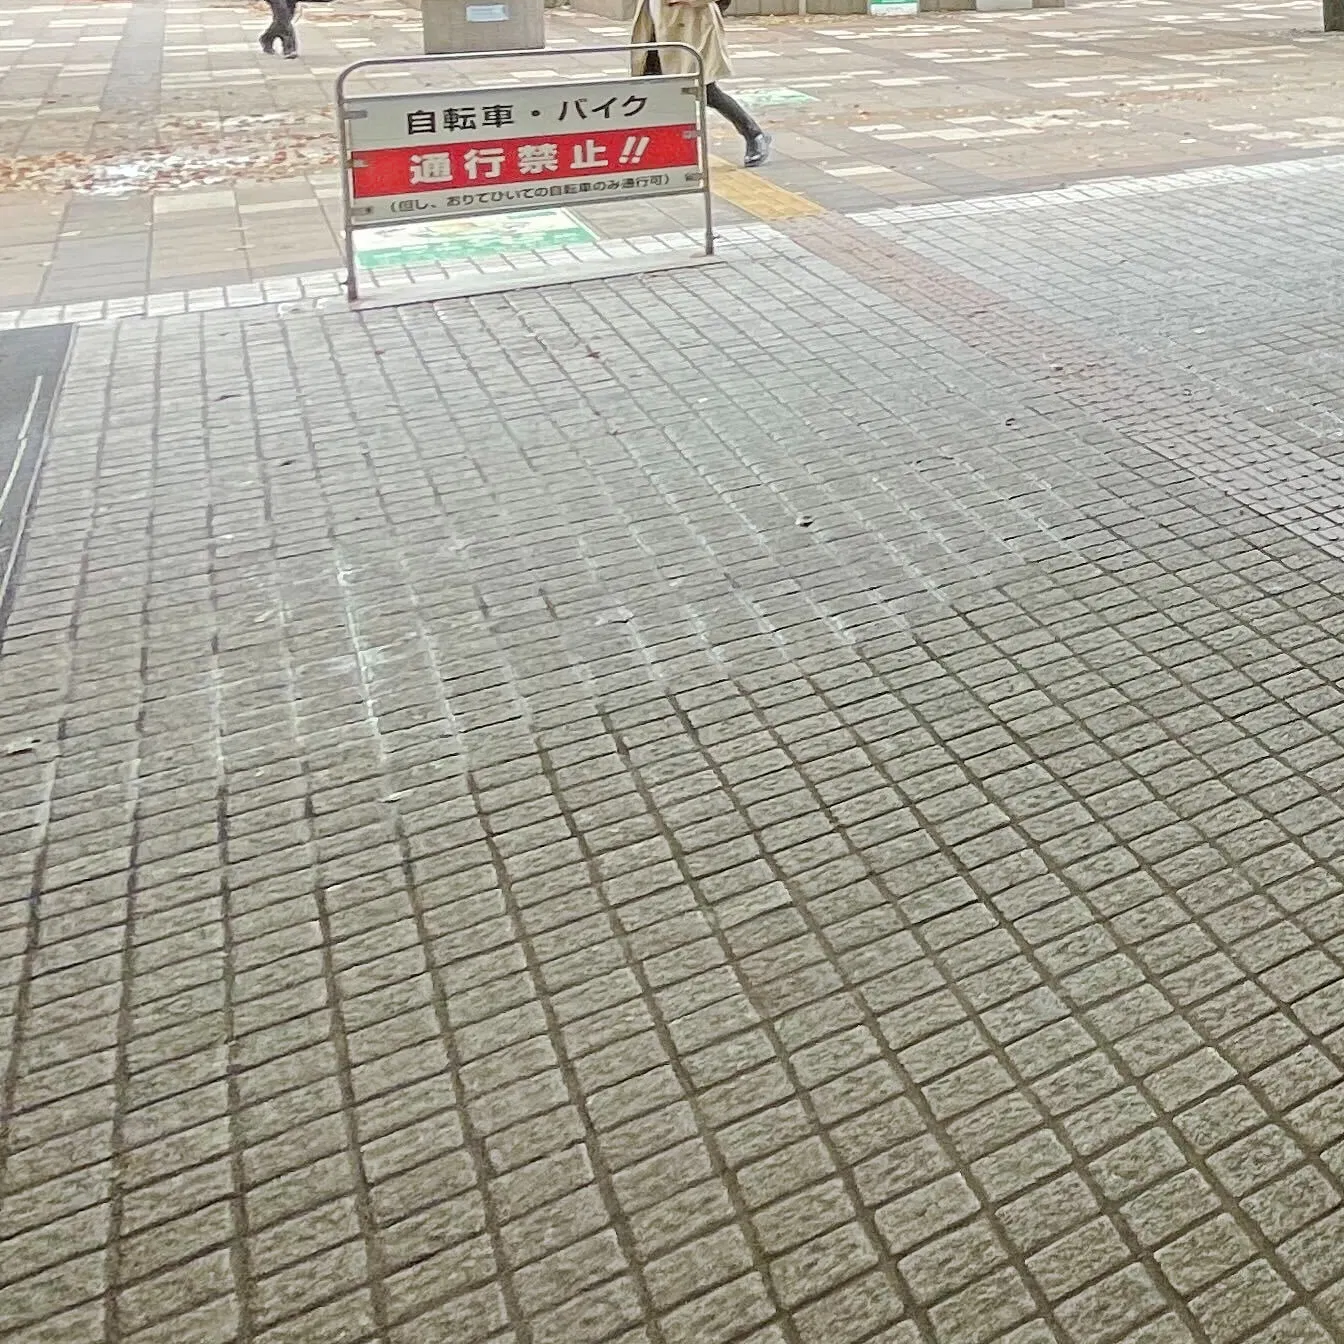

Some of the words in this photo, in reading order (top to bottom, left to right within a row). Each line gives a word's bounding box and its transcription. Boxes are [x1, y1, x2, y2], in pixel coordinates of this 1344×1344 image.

[406, 95, 648, 135] 自転車・バイク
